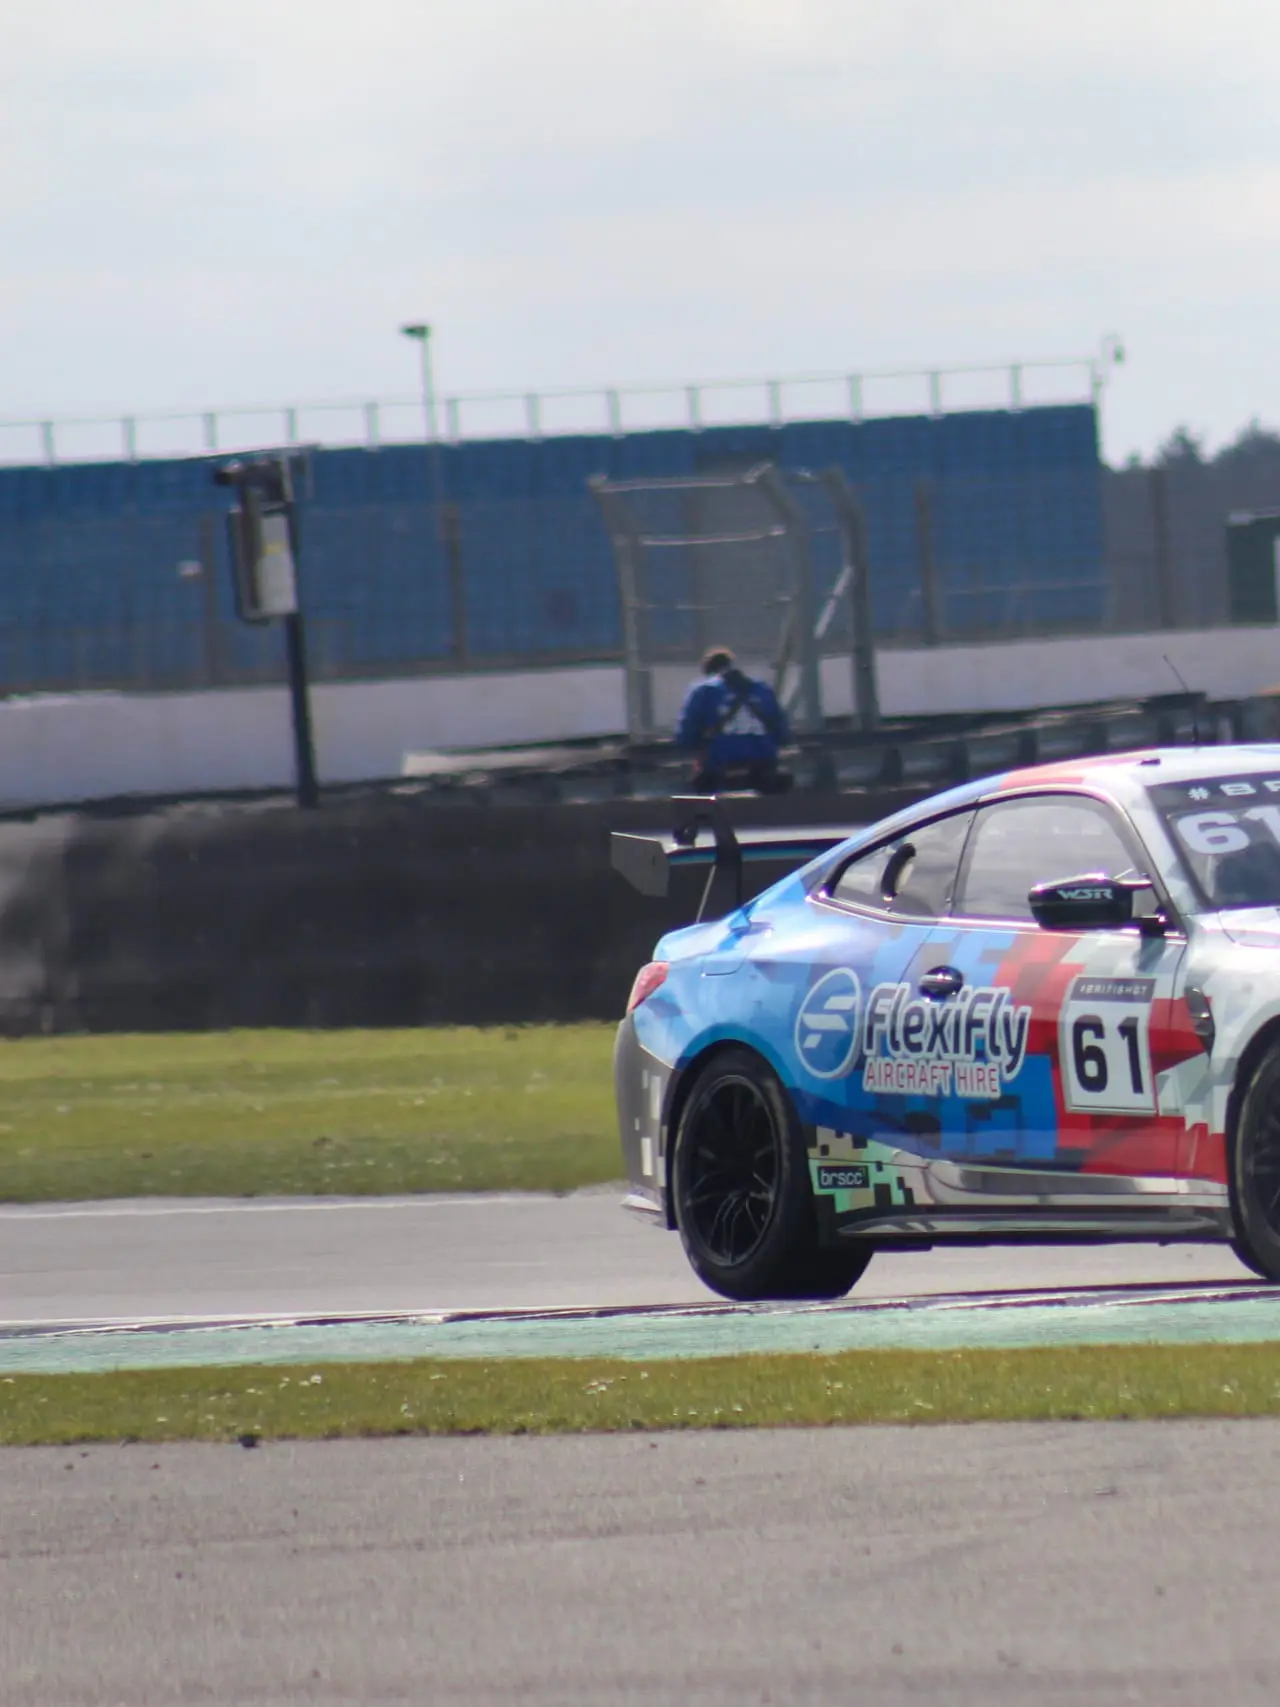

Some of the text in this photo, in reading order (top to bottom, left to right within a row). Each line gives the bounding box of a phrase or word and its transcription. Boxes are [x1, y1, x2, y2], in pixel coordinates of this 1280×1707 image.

[1057, 888, 1113, 900] WSR
[1072, 1014, 1144, 1094] 61
[864, 1061, 1000, 1094] AIRCRAFT HIRE
[820, 1168, 863, 1186] brscc
